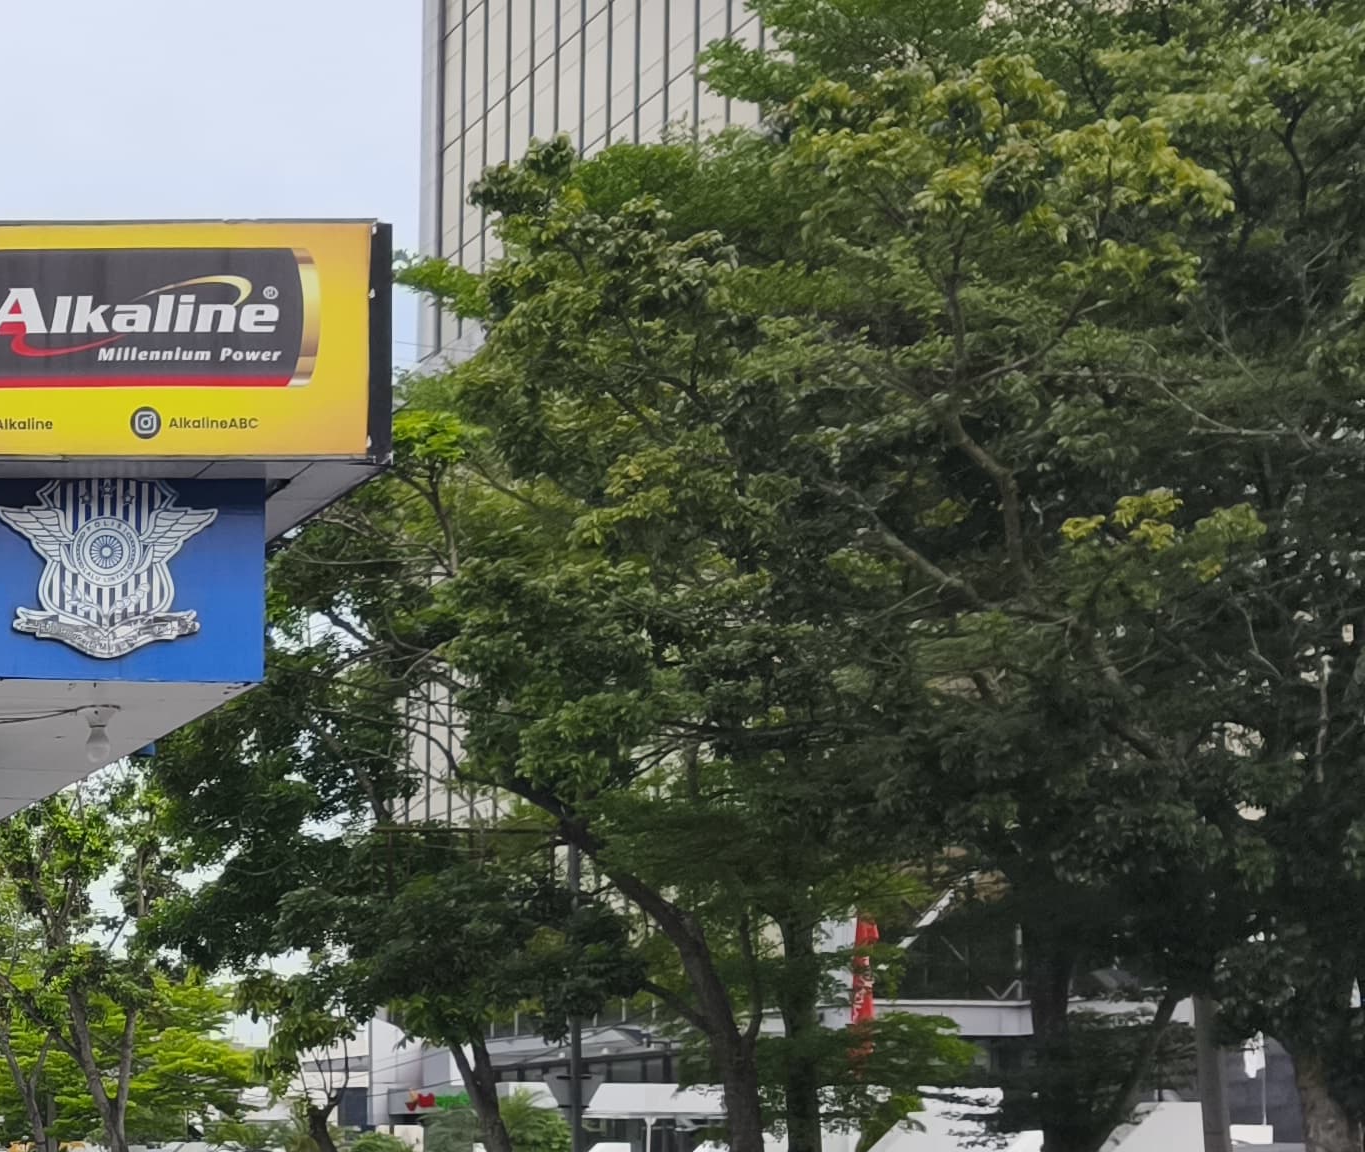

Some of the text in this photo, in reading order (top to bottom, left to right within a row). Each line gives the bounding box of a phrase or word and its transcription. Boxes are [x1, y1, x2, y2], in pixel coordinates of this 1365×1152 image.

[98, 347, 282, 363] Millennium Power
[169, 416, 259, 430] AlkalineABC
